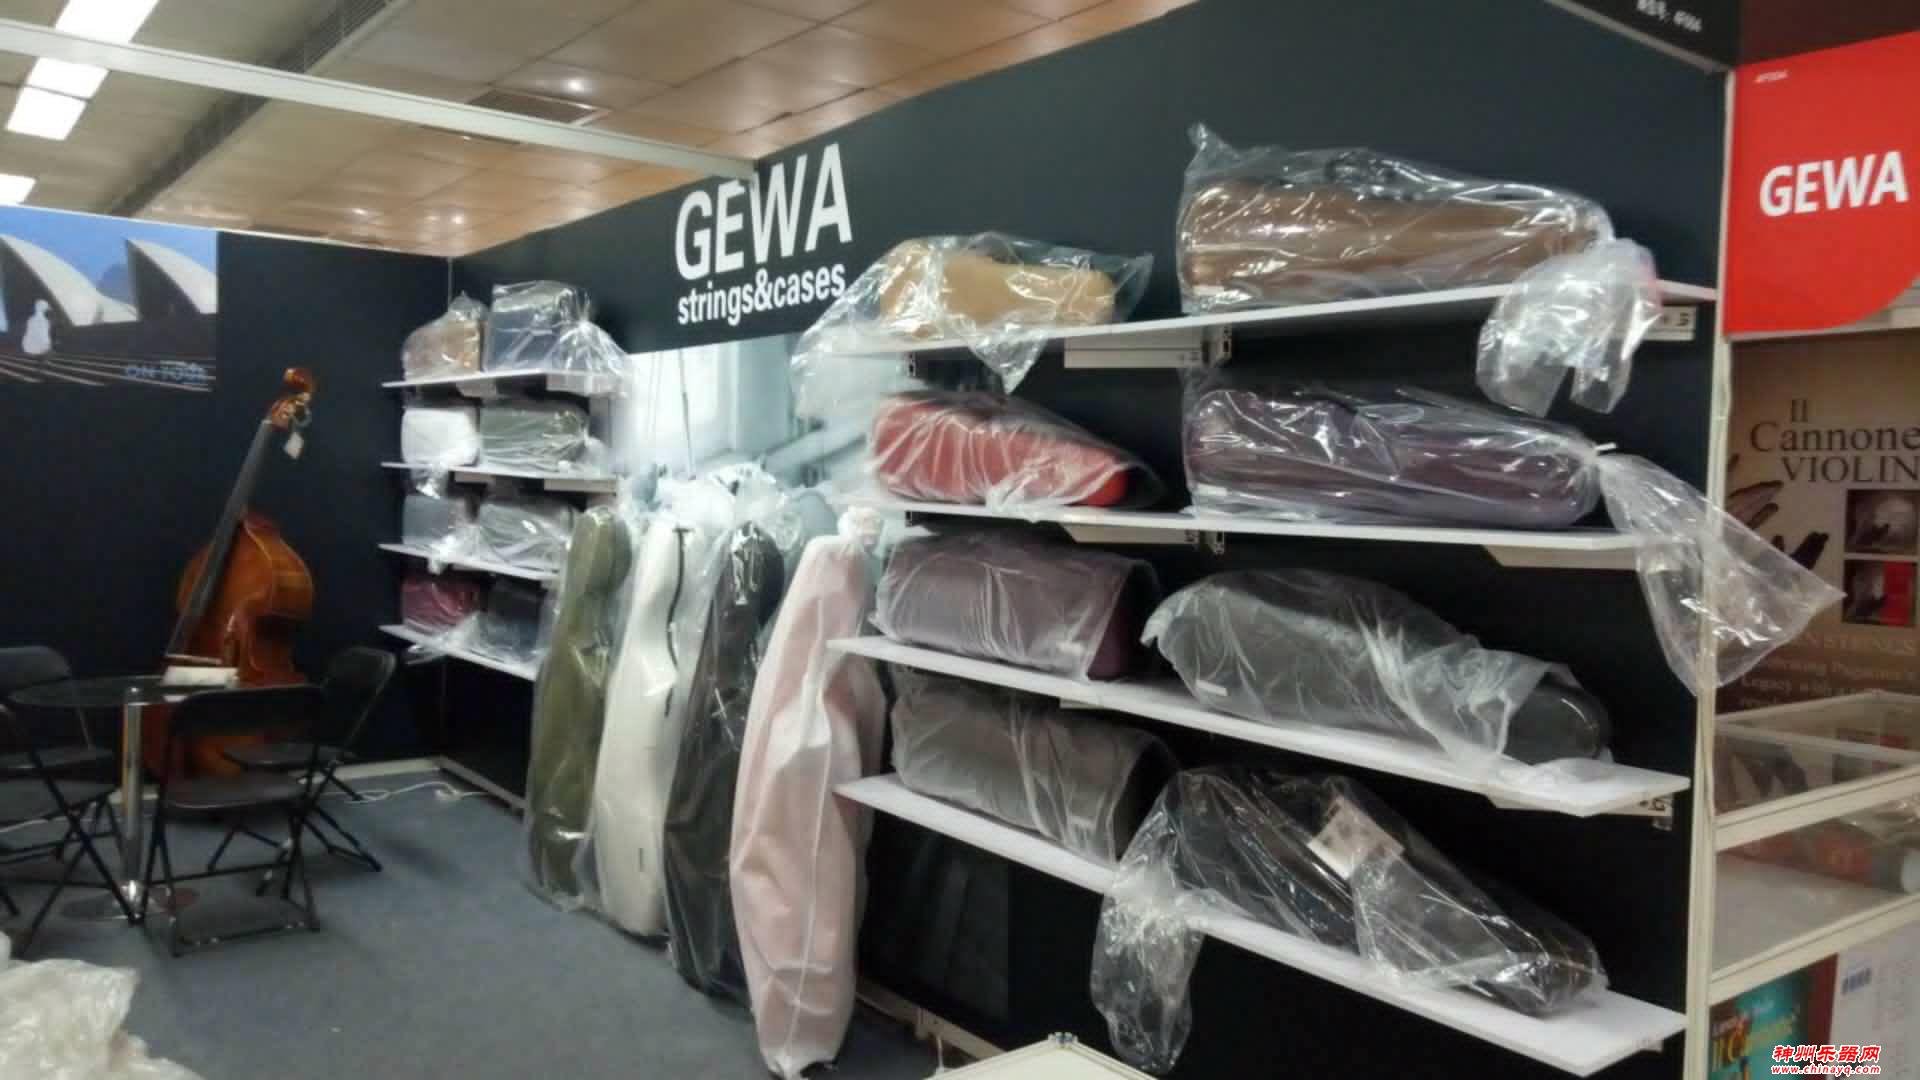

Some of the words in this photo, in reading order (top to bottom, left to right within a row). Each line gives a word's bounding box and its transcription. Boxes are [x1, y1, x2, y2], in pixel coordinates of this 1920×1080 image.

[675, 142, 853, 280] GEWA
[1759, 150, 1910, 217] GEWA
[677, 263, 846, 326] strings&cases
[1750, 422, 1920, 452] Cannone
[1781, 455, 1920, 483] VIOLIN
